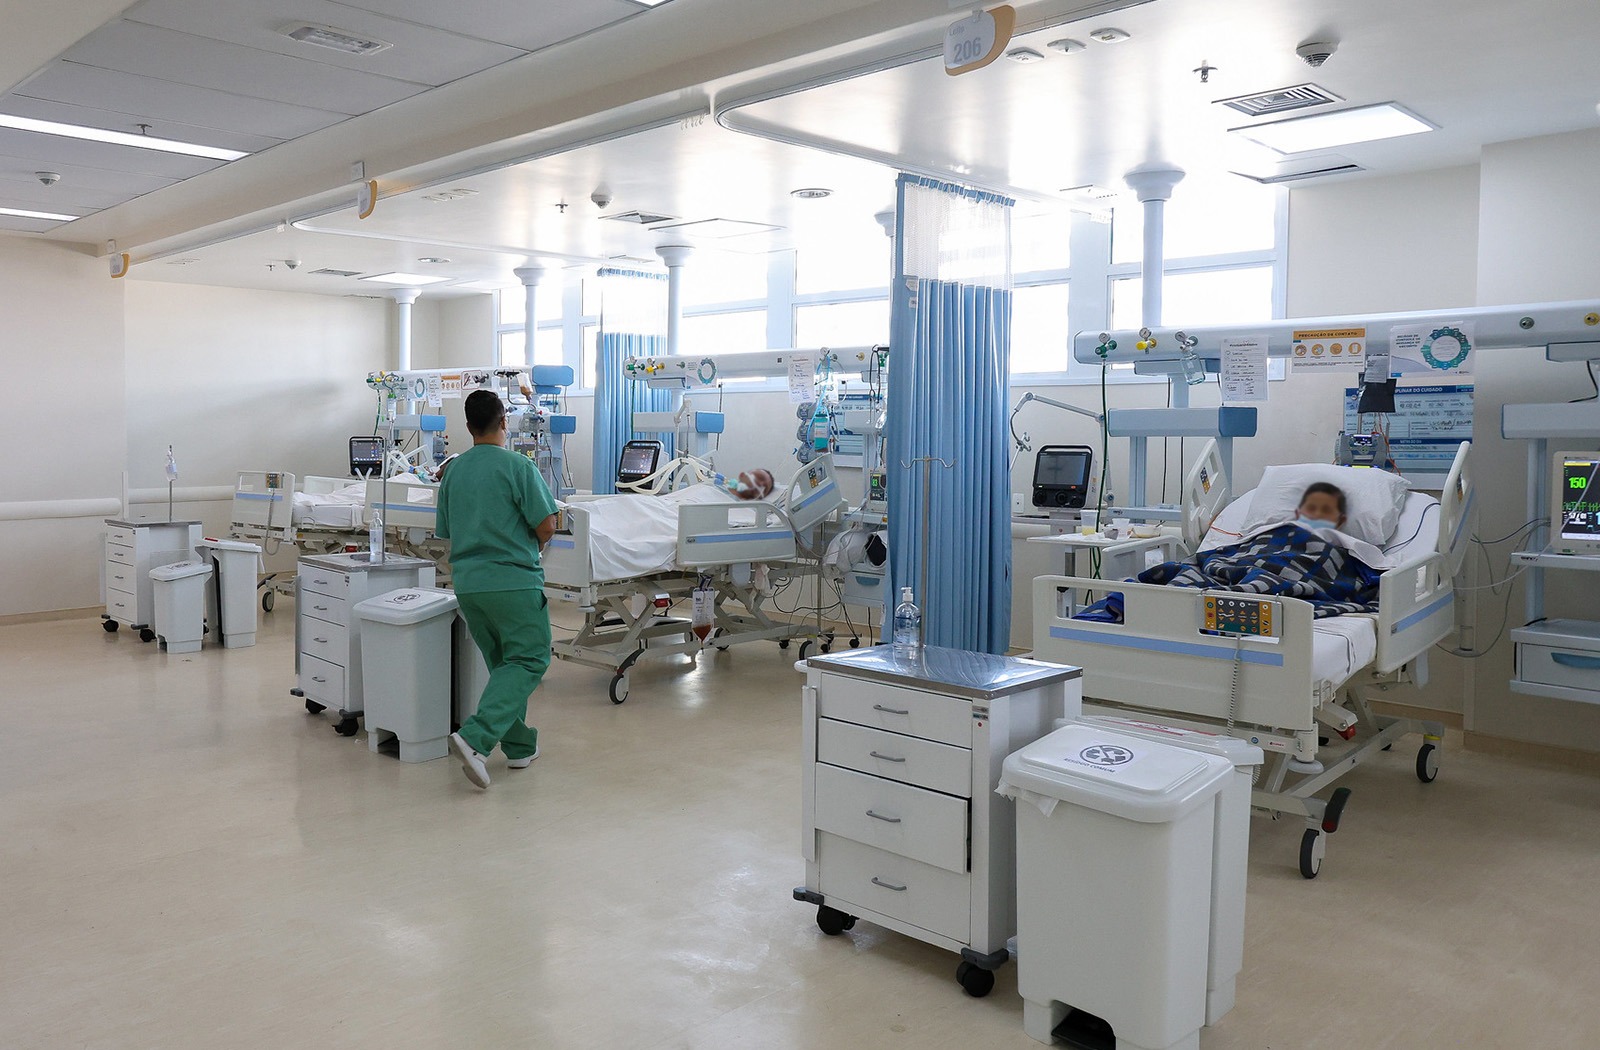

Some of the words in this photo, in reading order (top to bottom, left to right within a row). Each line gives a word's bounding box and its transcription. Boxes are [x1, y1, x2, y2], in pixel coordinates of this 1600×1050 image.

[949, 25, 965, 36] Leito
[954, 37, 981, 64] 206
[1568, 476, 1587, 489] 150
